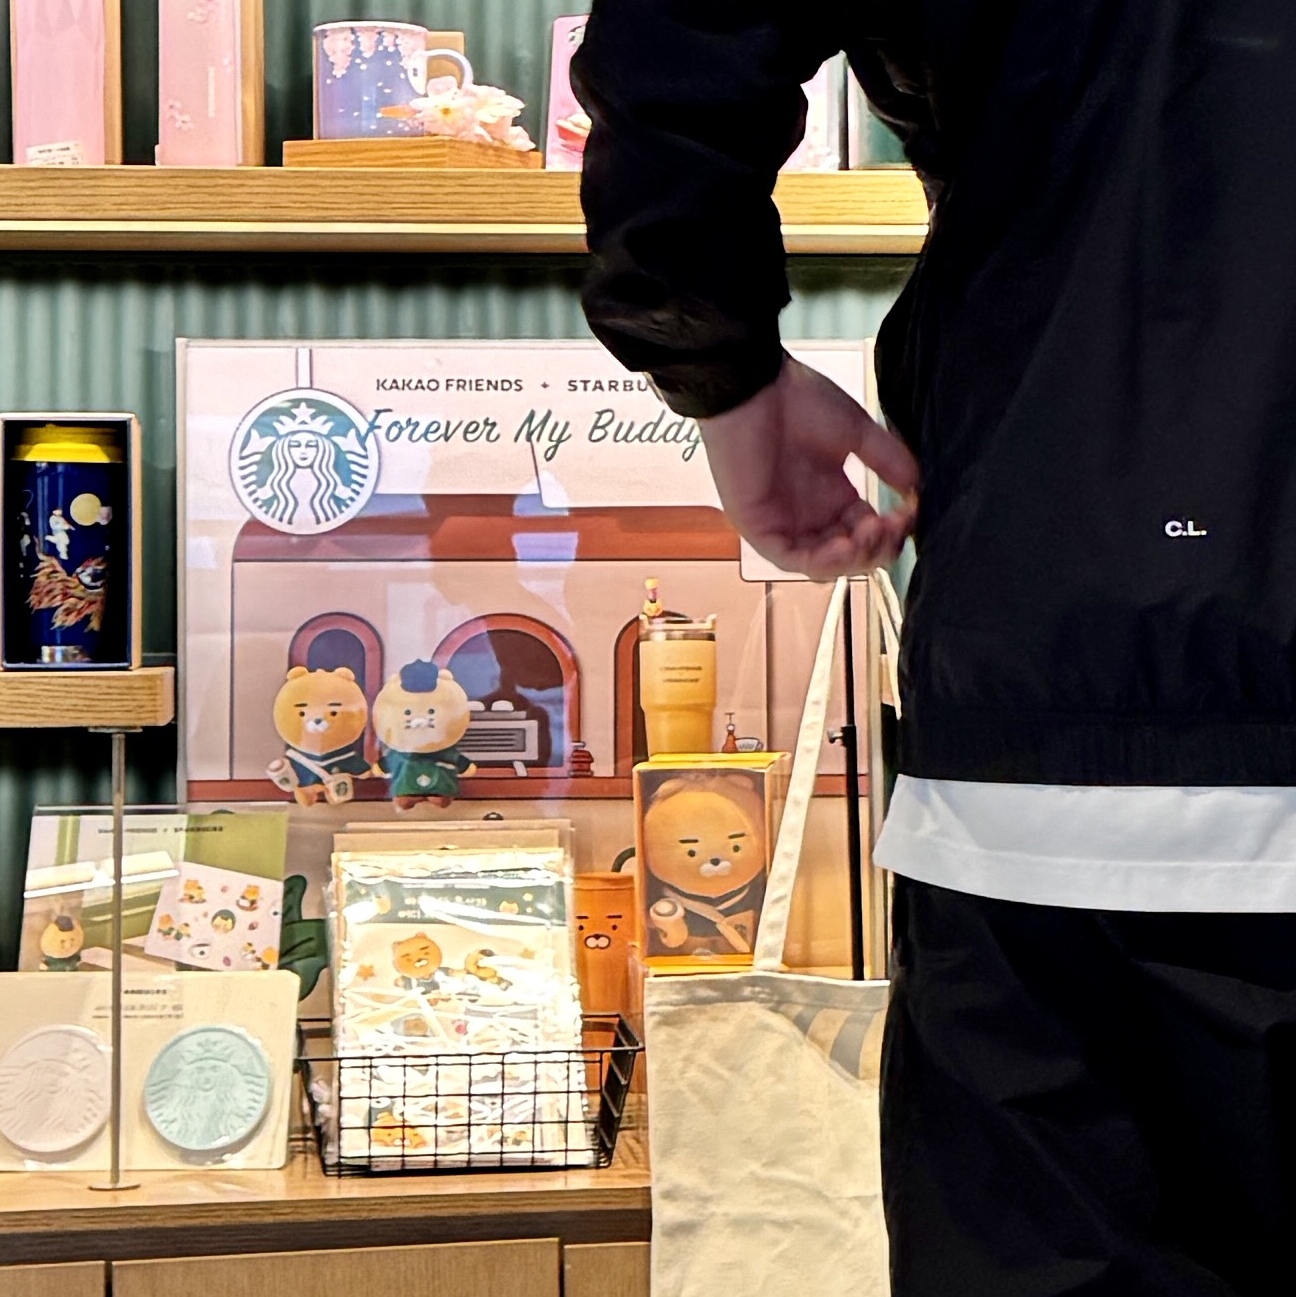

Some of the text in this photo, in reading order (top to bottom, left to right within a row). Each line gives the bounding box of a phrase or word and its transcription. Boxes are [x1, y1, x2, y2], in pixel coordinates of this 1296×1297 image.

[376, 379, 440, 392] KAKAO
[444, 379, 524, 393] FRIENDS
[566, 379, 650, 393] STARBU
[361, 408, 704, 462] Forever My Buddy
[1165, 520, 1207, 537] C.L.
